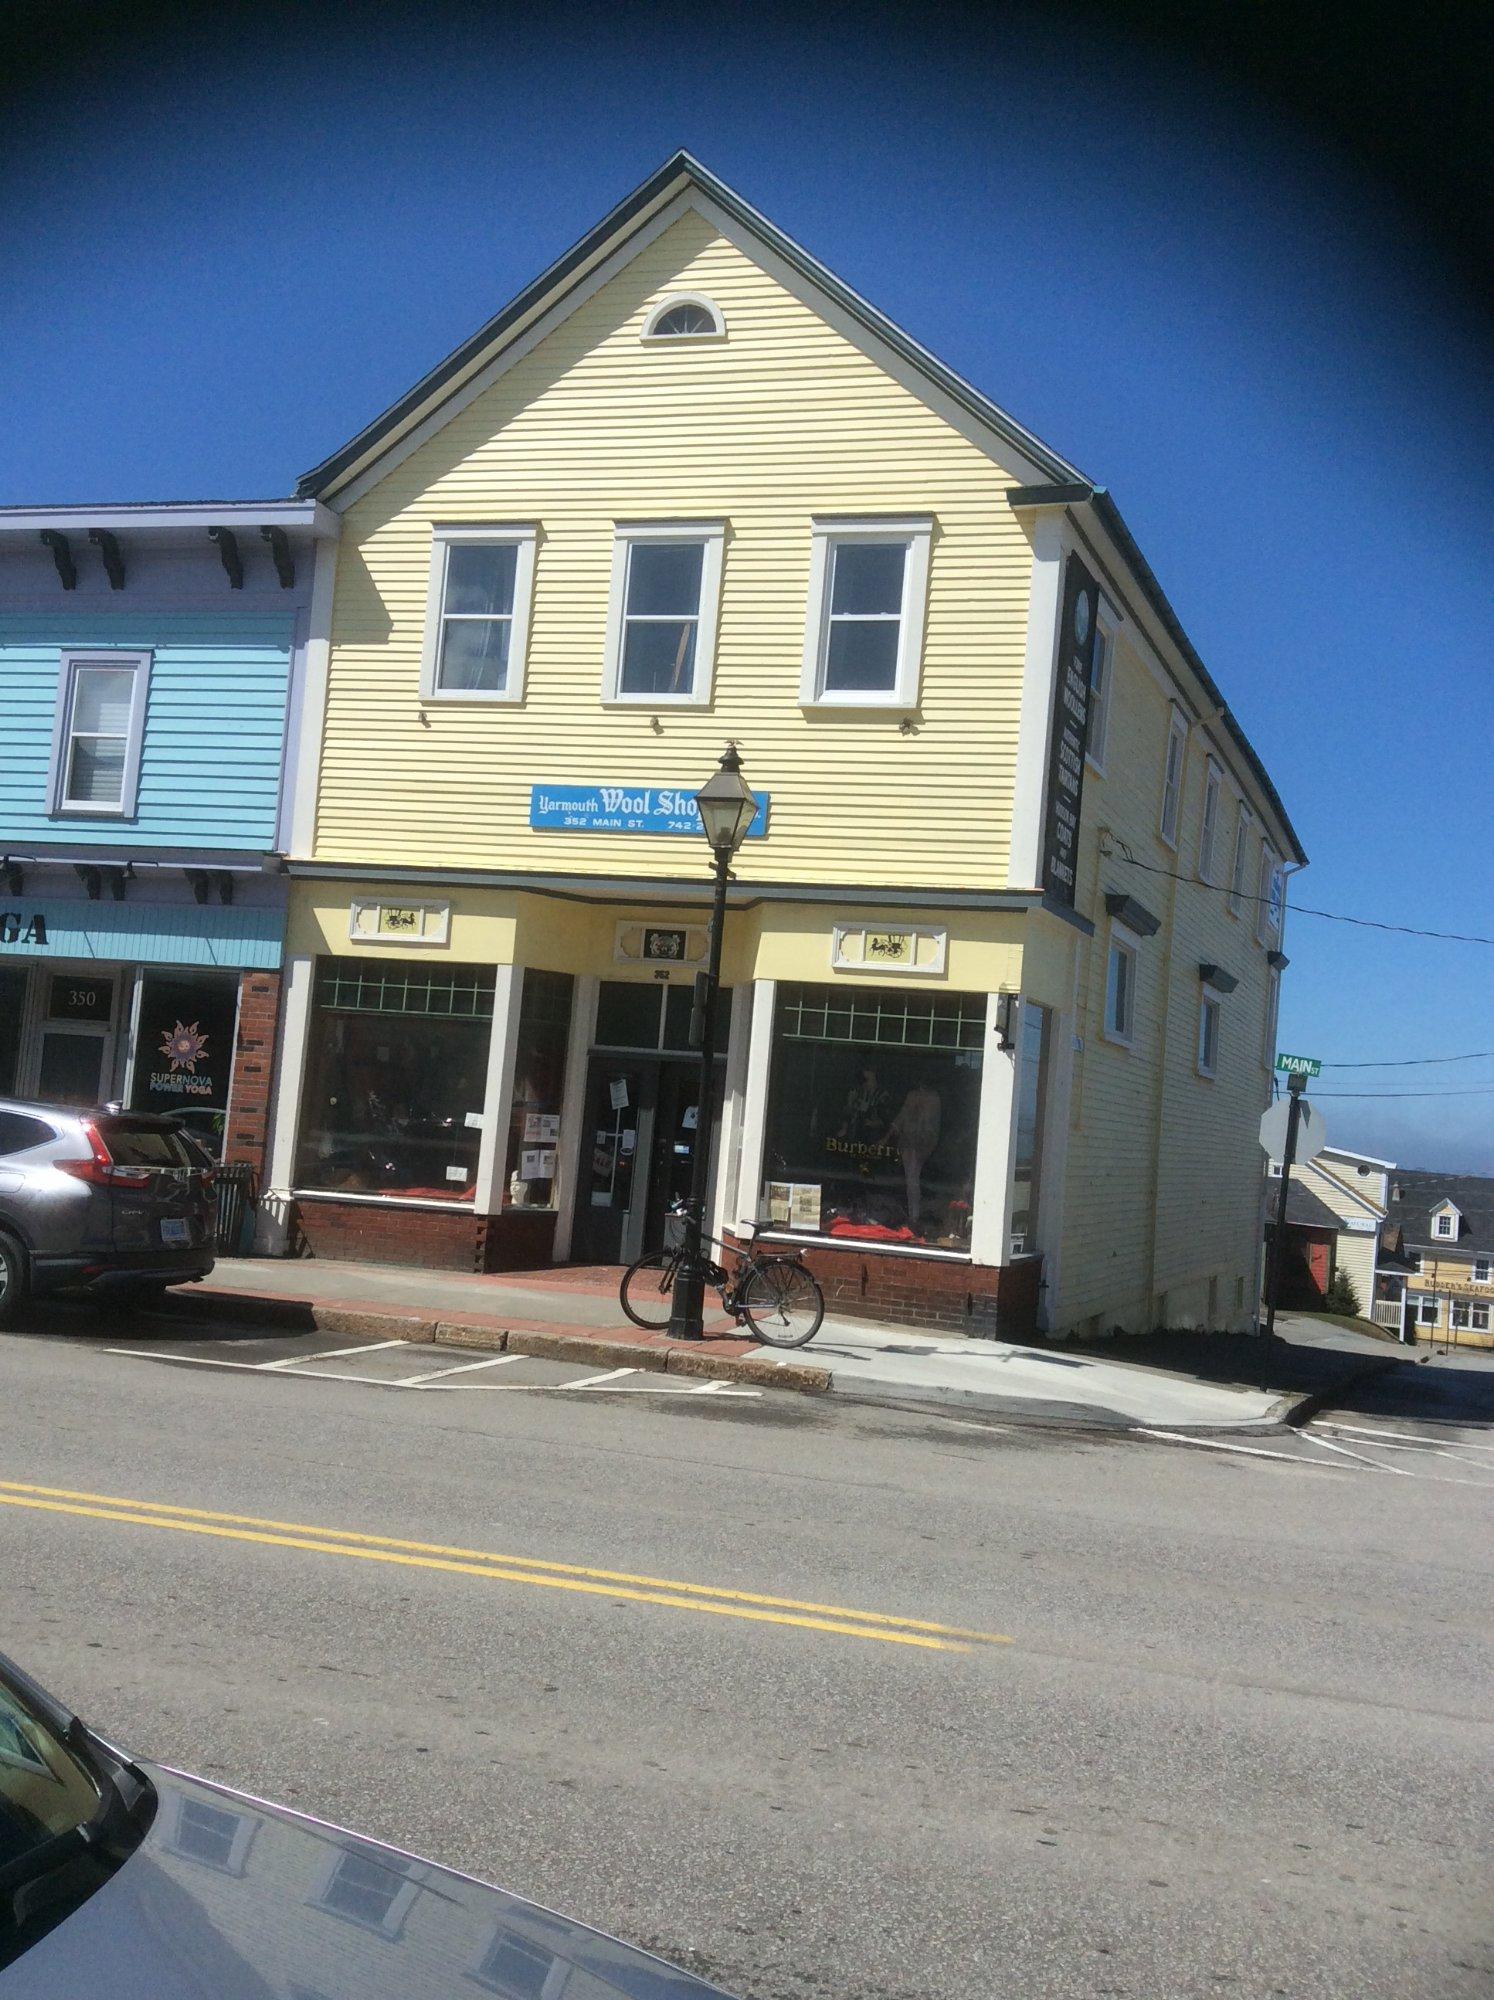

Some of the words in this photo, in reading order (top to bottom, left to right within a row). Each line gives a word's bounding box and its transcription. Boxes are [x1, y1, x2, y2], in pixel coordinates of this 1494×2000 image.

[538, 795, 599, 814] Yarmouth
[600, 788, 651, 815] Wool
[653, 790, 702, 821] Sho
[564, 817, 587, 826] 352
[592, 818, 622, 827] MAIN
[627, 819, 644, 828] ST.
[667, 821, 692, 829] 742
[68, 990, 96, 1006] 350
[1281, 1055, 1313, 1074] MAIN
[1311, 1067, 1319, 1075] ST
[150, 1072, 213, 1087] SUPERNOVA
[149, 1081, 184, 1094] POWER
[184, 1084, 213, 1096] YOGA
[825, 1137, 903, 1164] Burberry
